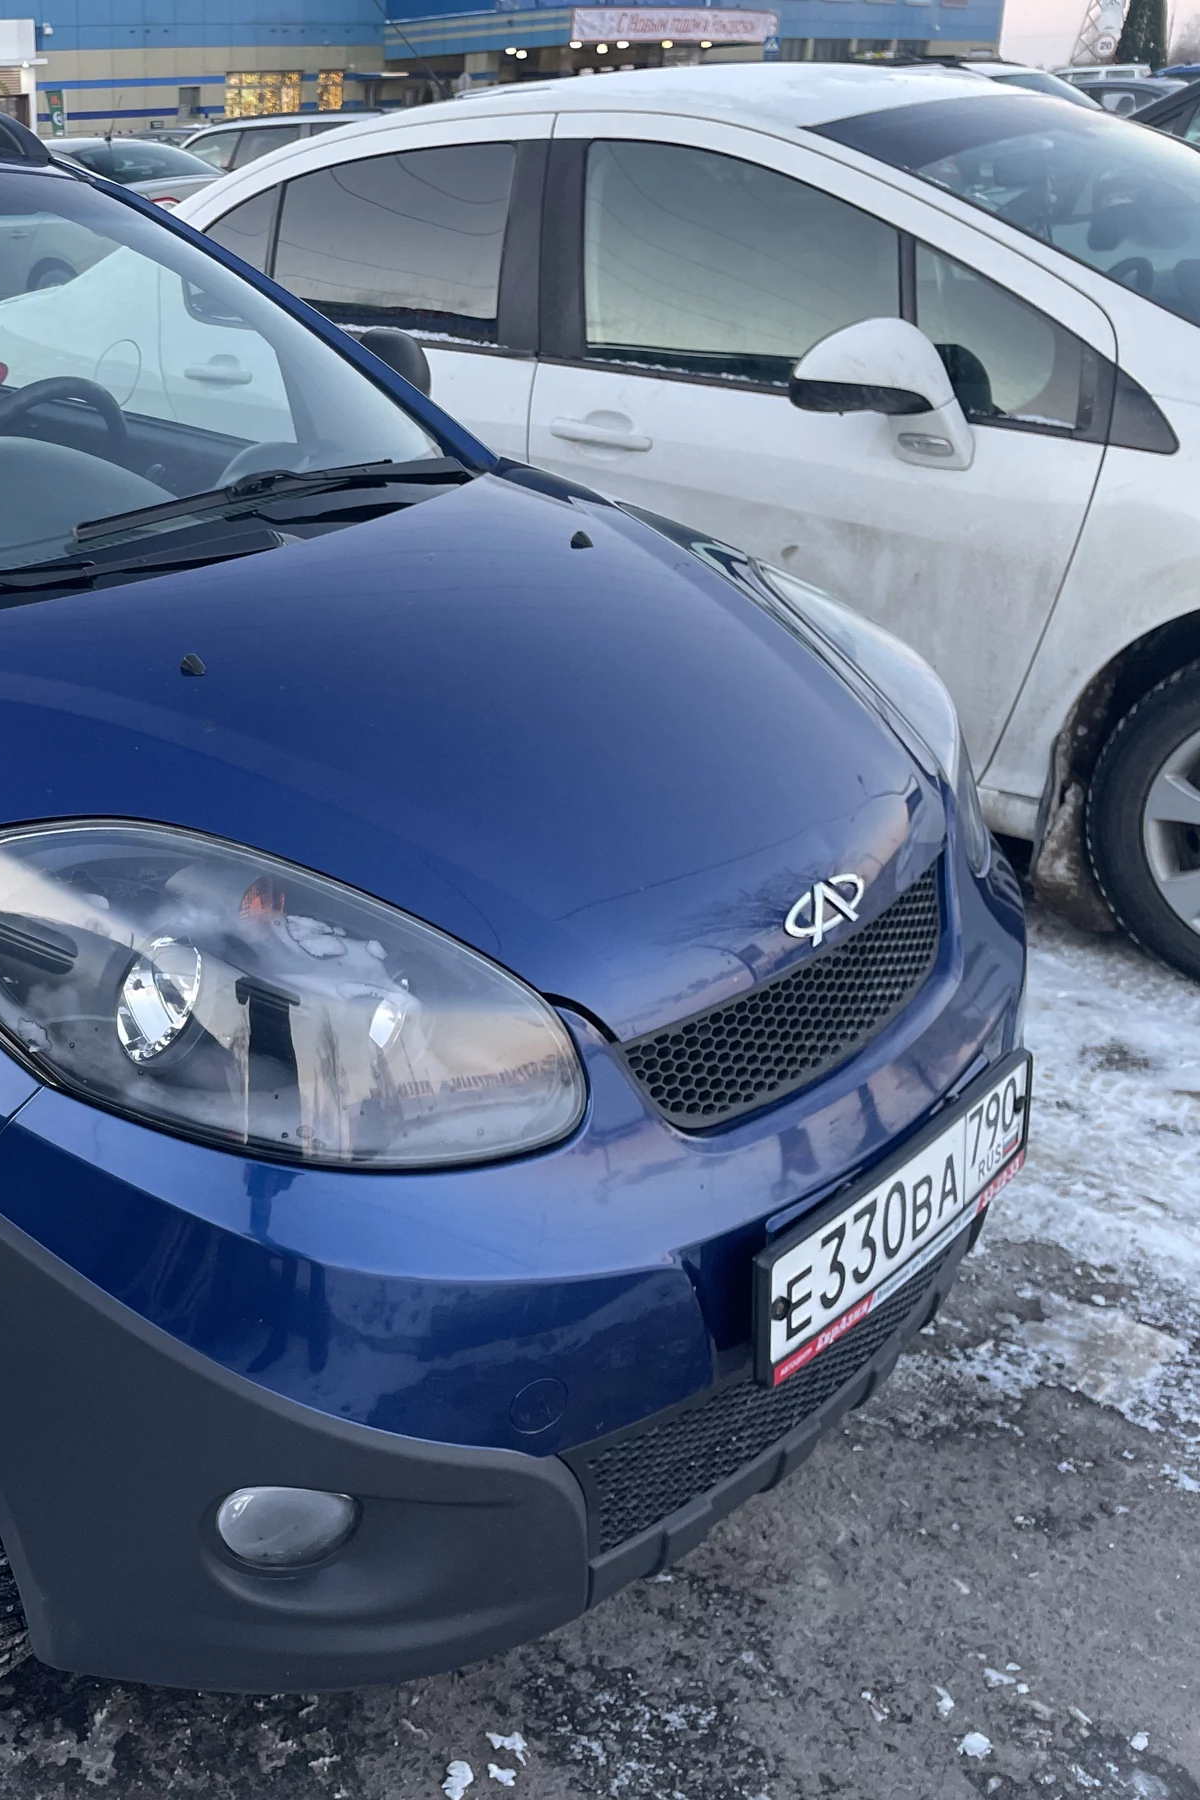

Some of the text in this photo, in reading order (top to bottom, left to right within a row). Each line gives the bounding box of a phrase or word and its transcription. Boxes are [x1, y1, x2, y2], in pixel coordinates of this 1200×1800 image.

[1099, 41, 1112, 50] 20
[968, 1077, 1018, 1168] 790
[978, 1143, 1002, 1182] RUS
